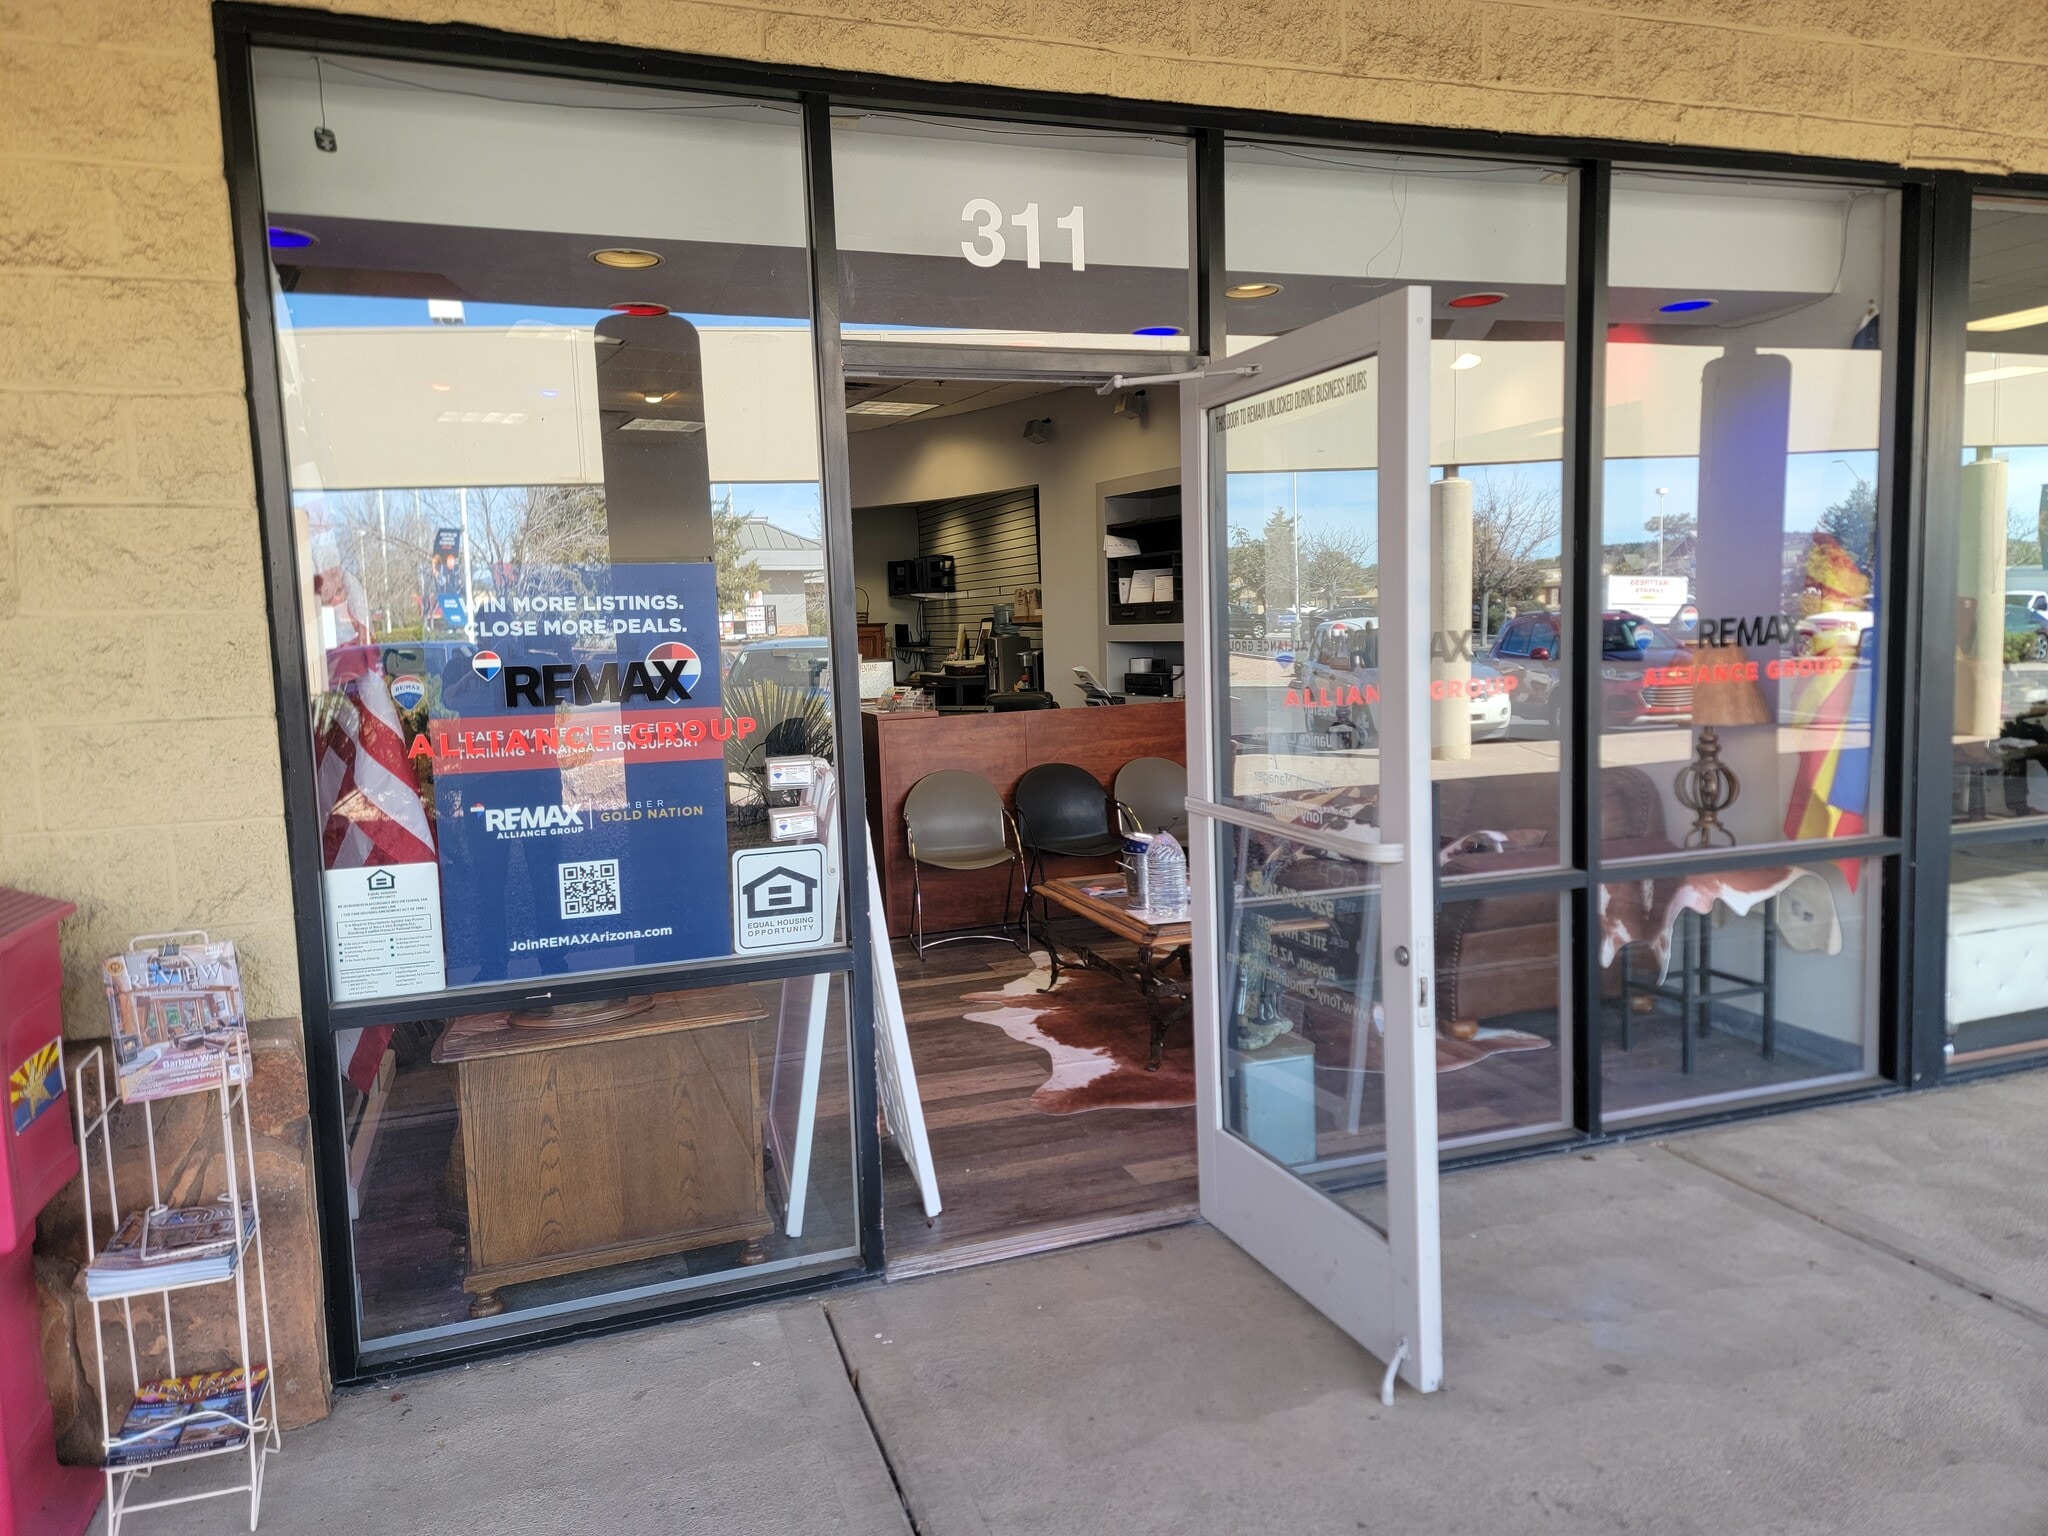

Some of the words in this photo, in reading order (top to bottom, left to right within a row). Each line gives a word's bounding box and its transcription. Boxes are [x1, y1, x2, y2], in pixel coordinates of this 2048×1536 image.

[961, 198, 1085, 272] 311
[1216, 413, 1226, 432] THIS
[1226, 410, 1239, 430] DOOR
[1240, 408, 1246, 426] TO
[1247, 404, 1266, 424] REMAIN
[1267, 394, 1294, 418] UNLOCKED
[1294, 386, 1316, 410] DURING
[1316, 377, 1345, 404] BUSINESS
[1345, 370, 1368, 395] HOURS
[459, 597, 506, 613] WIN
[514, 596, 578, 612] MORE
[583, 594, 684, 612] LISTINGS.
[464, 620, 538, 637] CLOSE
[544, 618, 609, 636] MORE
[614, 617, 688, 634] DEALS.
[1699, 615, 1799, 648] REMAX
[503, 660, 692, 708] REMAX
[1642, 661, 1760, 687] ALLIANCE
[1765, 658, 1843, 680] GROUP
[1284, 684, 1380, 708] ALLIAN
[1430, 675, 1518, 700] GROUP
[408, 724, 610, 759] ALLIANCE
[629, 716, 758, 744] GROUP
[486, 804, 584, 832] REMAX
[600, 810, 642, 822] GOLD
[648, 806, 704, 819] NATION
[497, 828, 547, 840] ALLIANCE
[550, 826, 584, 836] GROUP
[748, 920, 775, 929] EQUAL
[777, 916, 815, 927] HOUSING
[748, 924, 815, 937] OPPORTUNITY
[510, 926, 672, 952] JoinREMAXArizona.com
[128, 964, 222, 988] REVIEW
[199, 1370, 260, 1388] ESTAE
